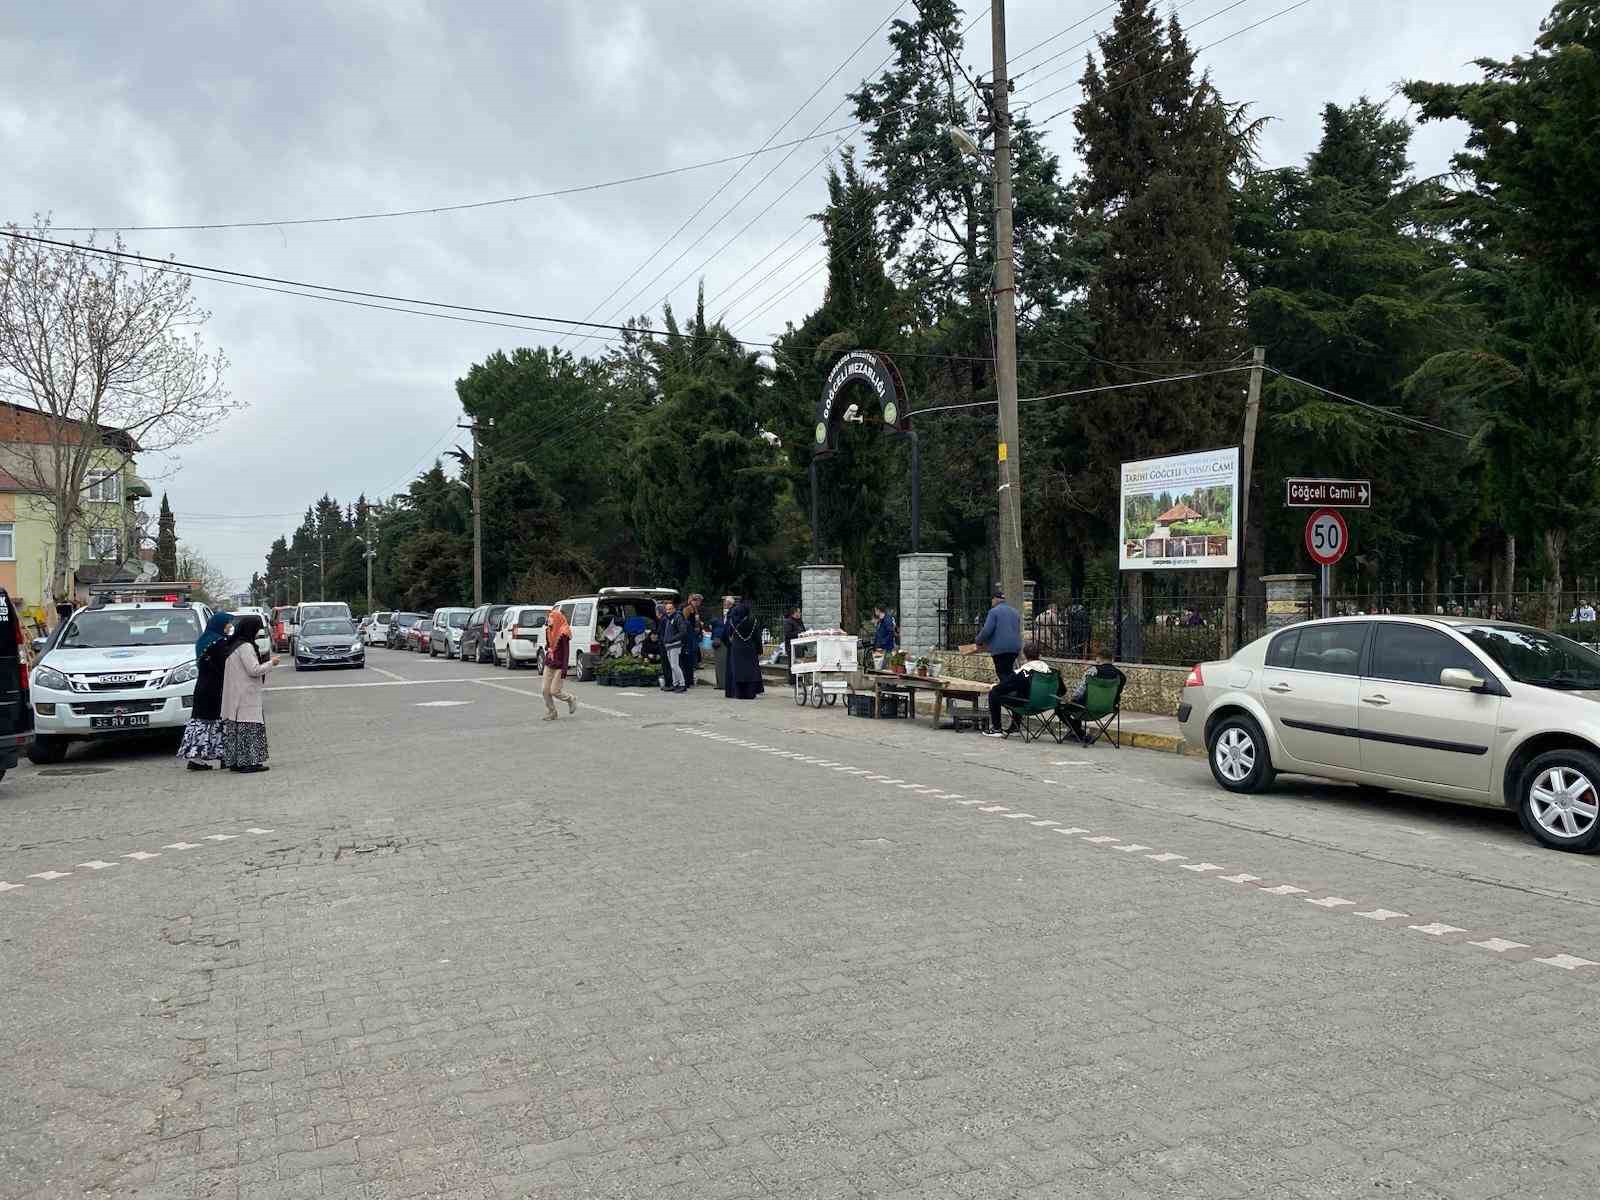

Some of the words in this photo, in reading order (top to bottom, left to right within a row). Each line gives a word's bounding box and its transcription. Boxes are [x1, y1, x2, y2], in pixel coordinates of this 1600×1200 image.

[1291, 484, 1326, 501] Göğceli
[1329, 486, 1356, 499] Camii
[1314, 524, 1339, 549] 50
